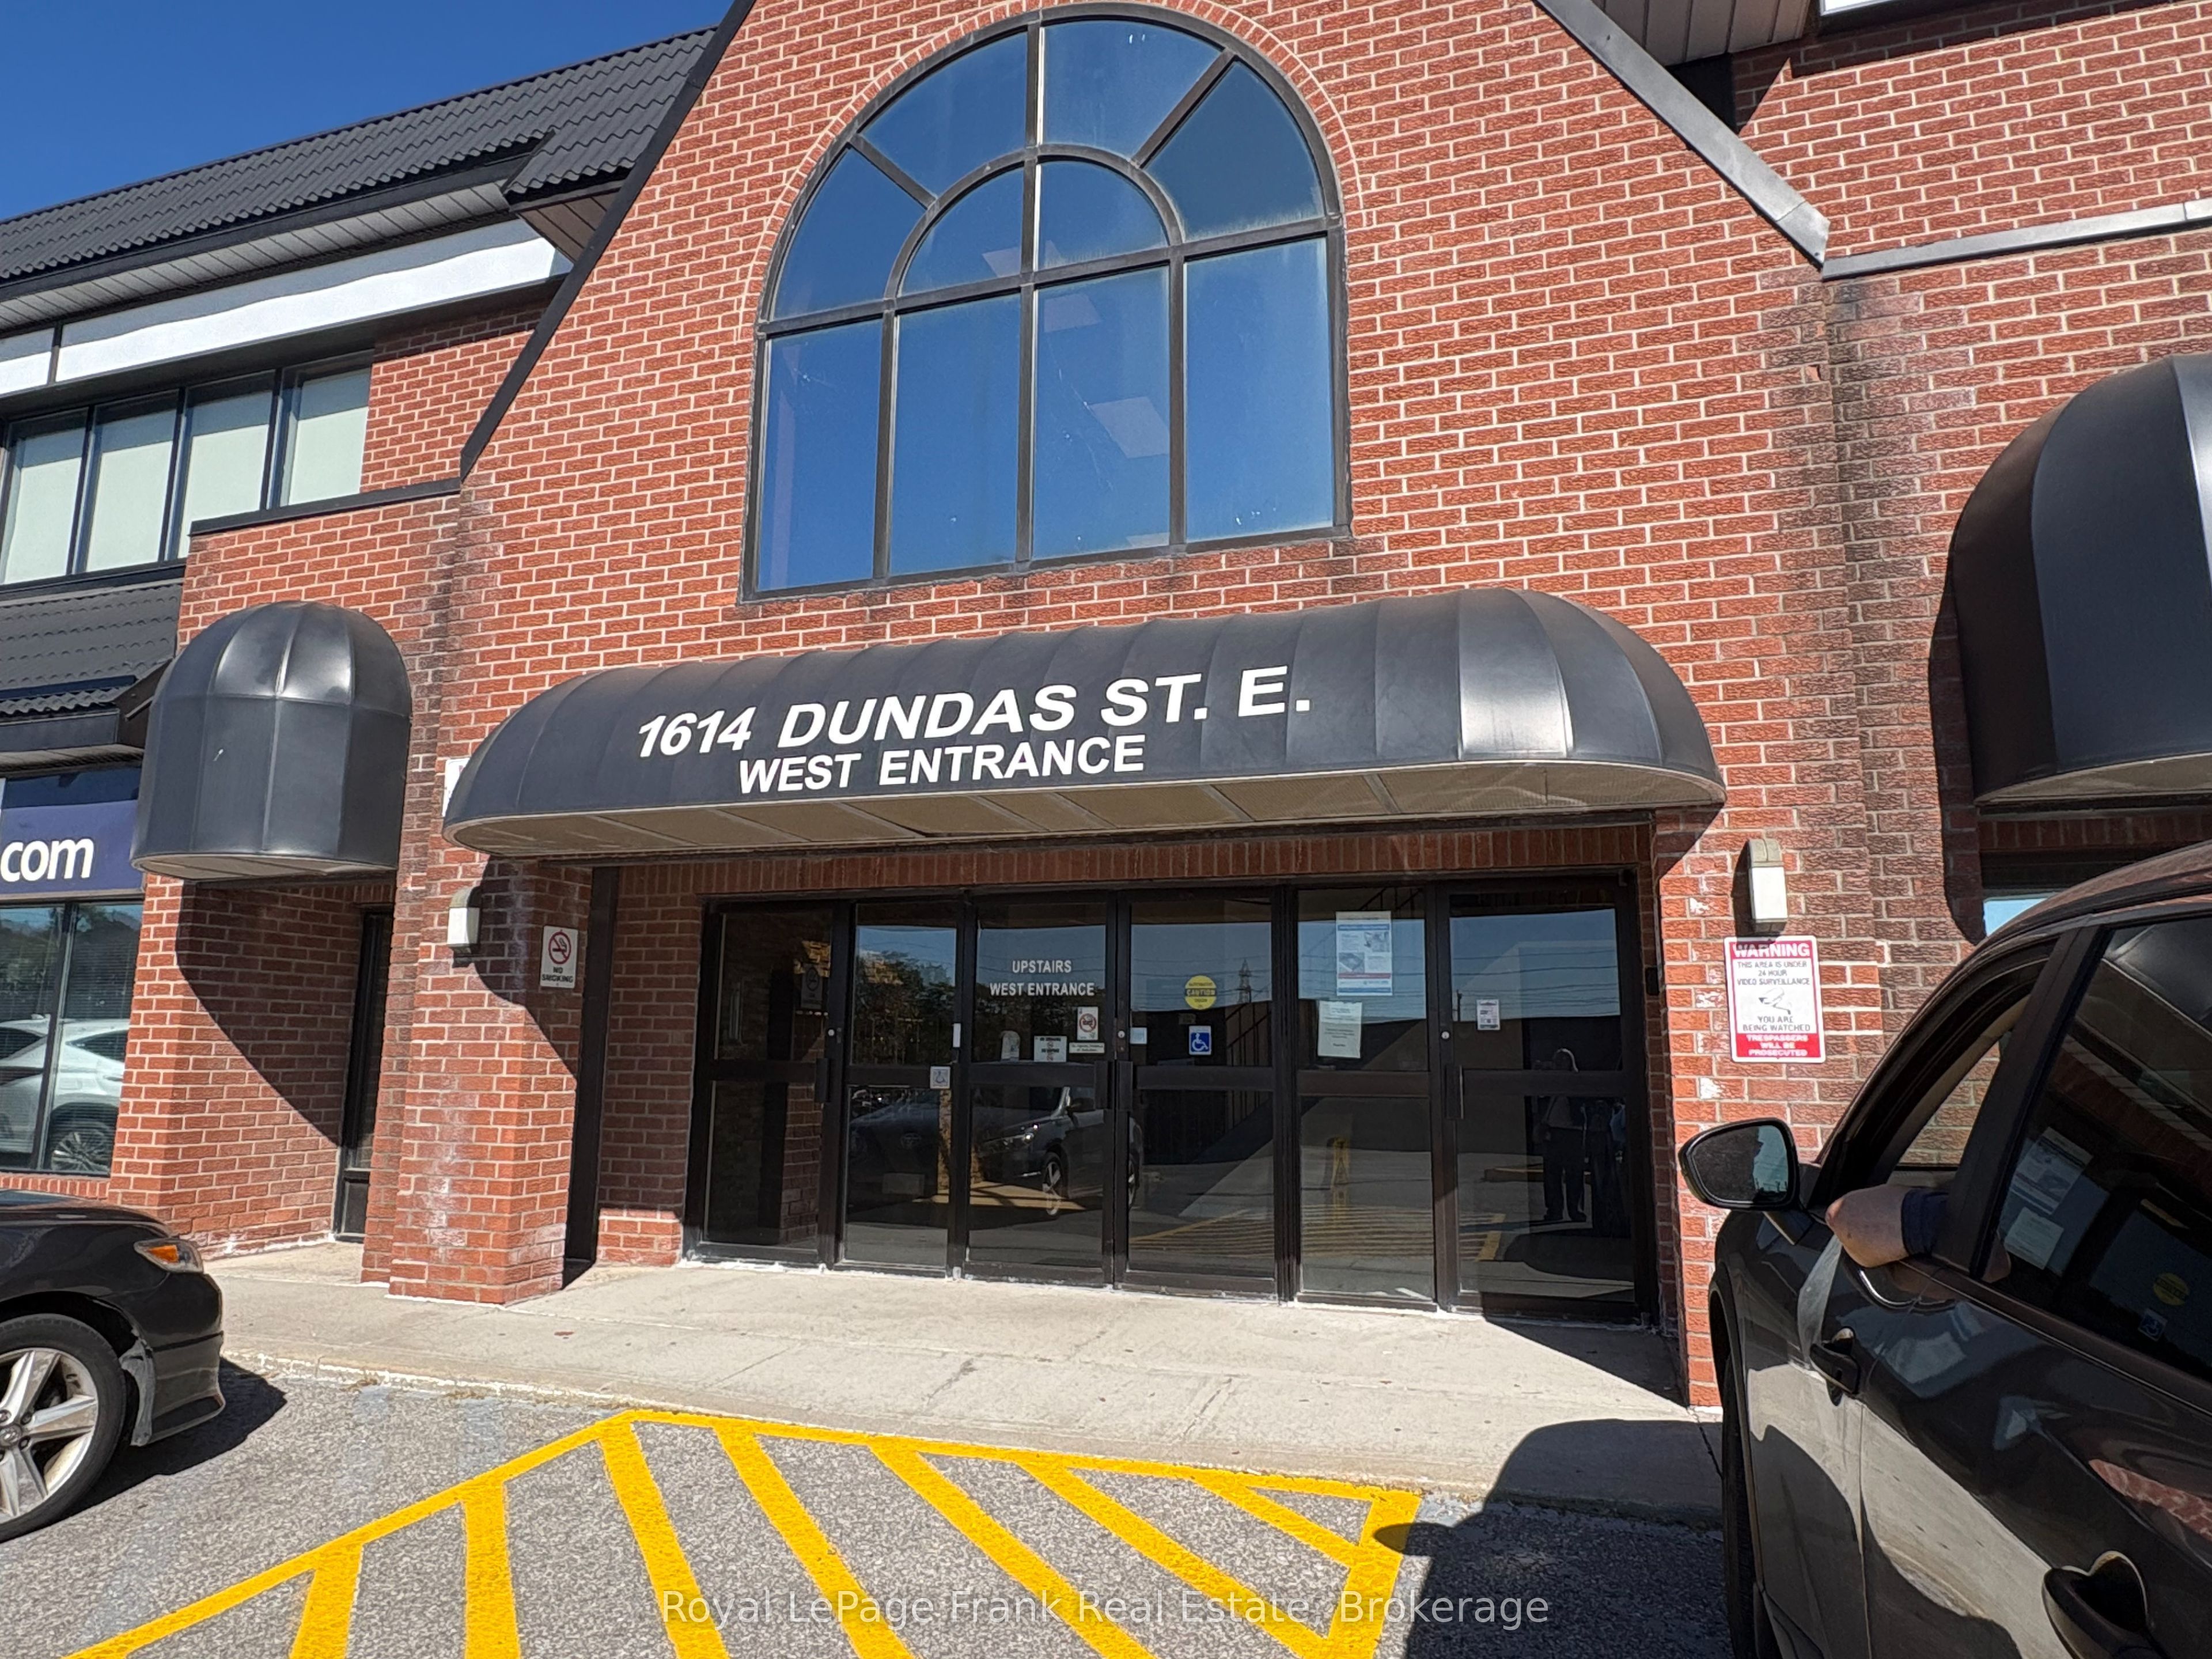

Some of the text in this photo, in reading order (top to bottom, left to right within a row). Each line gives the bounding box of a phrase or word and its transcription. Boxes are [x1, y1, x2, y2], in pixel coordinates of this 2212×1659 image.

[638, 665, 1310, 757] 1614 DUNDAS ST. E.
[738, 734, 1146, 794] WEST ENTRANCE
[1, 838, 94, 882] com
[1732, 942, 1810, 957] WARNING
[1012, 960, 1072, 974] UPSTAIRS
[542, 974, 573, 983] SMOKING
[990, 982, 1095, 996] WEST ENTRANCE
